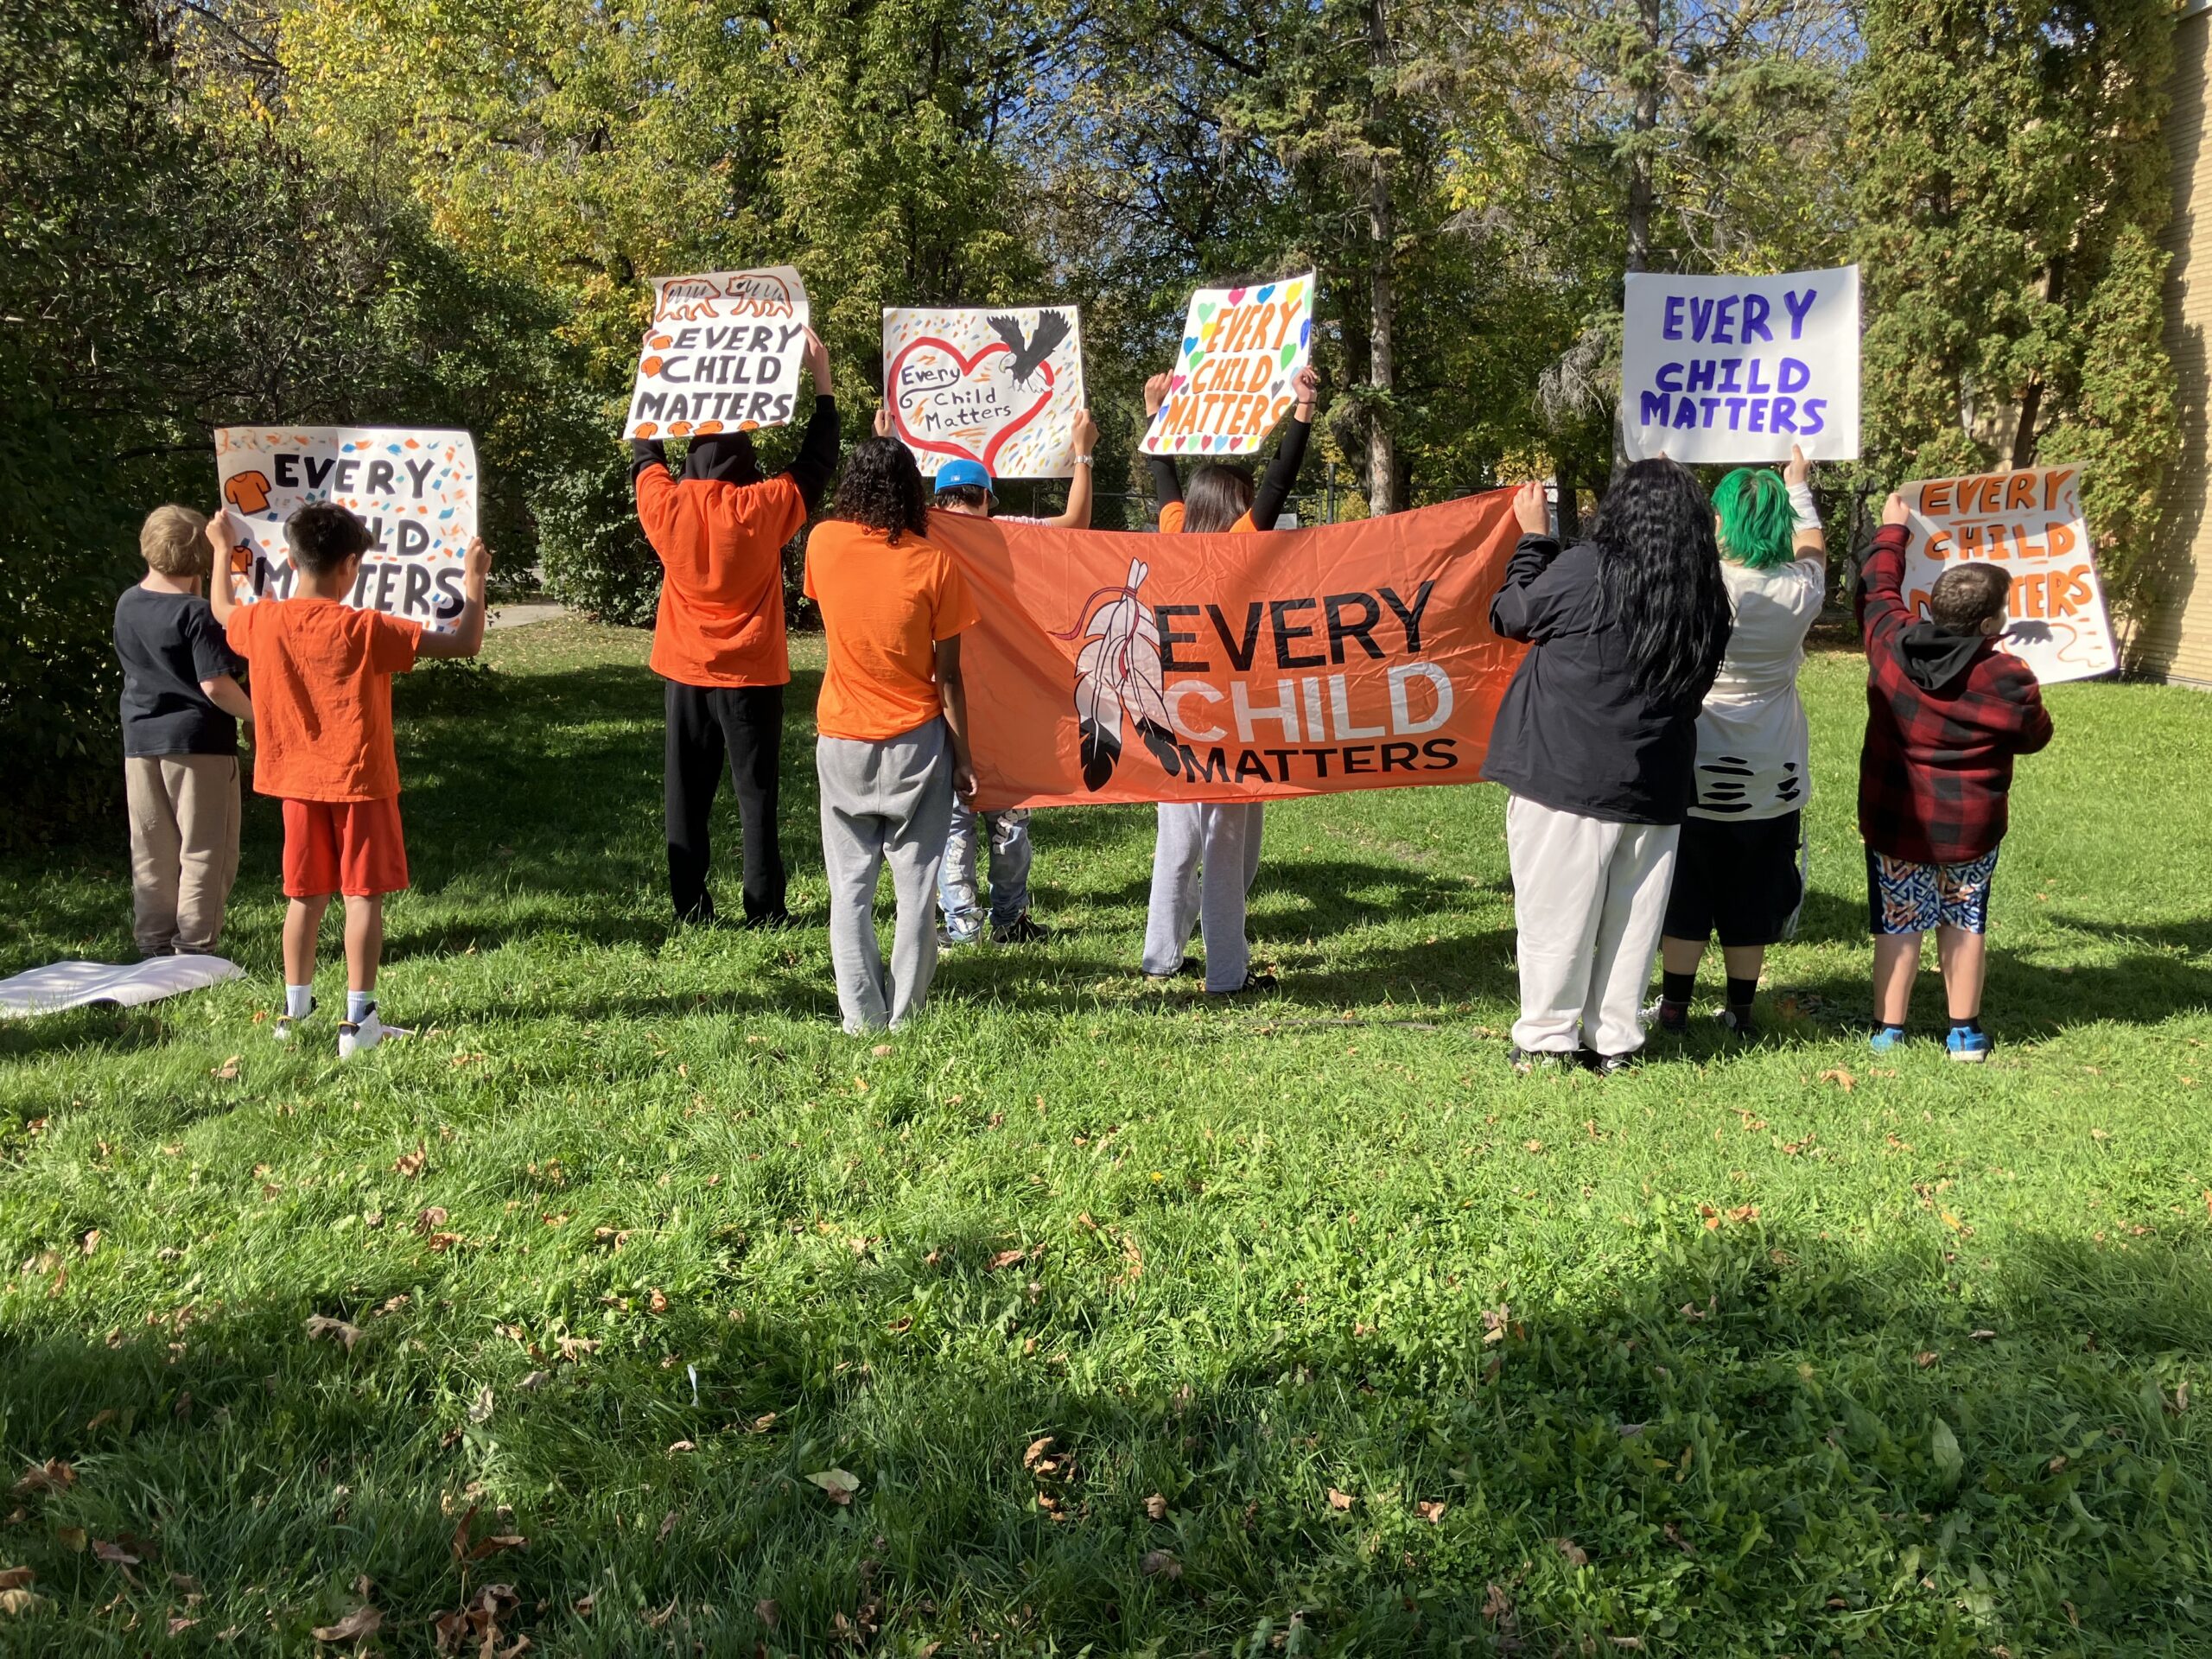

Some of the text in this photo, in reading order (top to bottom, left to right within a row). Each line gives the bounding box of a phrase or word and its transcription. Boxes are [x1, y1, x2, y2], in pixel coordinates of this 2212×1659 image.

[672, 322, 803, 353] EVERY
[1205, 298, 1302, 353] EVERY
[1662, 289, 1817, 344] EVERY
[659, 355, 782, 385] CHILD
[899, 365, 961, 409] Every
[1192, 355, 1273, 394] CHILD
[1655, 357, 1811, 394] CHILD
[635, 391, 793, 422] MATTERS
[925, 404, 1012, 432] Matters
[934, 387, 996, 405] Child
[1159, 394, 1292, 437] MATTERS
[1640, 391, 1827, 435] MATTERS
[274, 454, 435, 499] EVERY
[1920, 470, 2075, 516] EVERY
[1923, 522, 2076, 560] CHILD
[254, 557, 466, 619] MTERS
[1152, 579, 1435, 672] EVERY
[1162, 662, 1454, 743] CHILD
[1178, 738, 1459, 784] MATTERS
